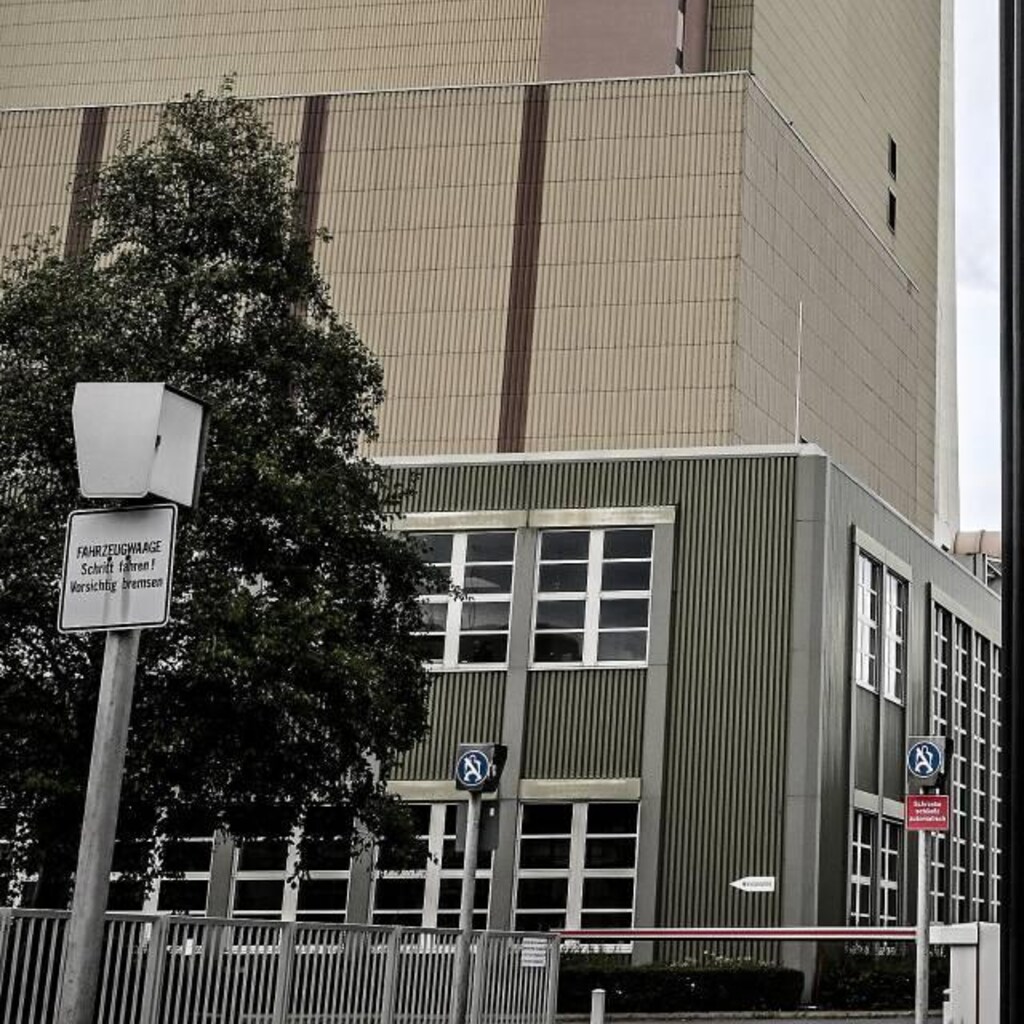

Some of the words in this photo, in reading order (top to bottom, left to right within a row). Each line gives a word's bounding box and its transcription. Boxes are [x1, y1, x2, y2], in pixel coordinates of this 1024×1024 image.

[77, 540, 162, 559] FAHRZEUGWAAGE
[81, 560, 114, 575] Schritt
[70, 579, 117, 594] Vorsichtig
[122, 577, 164, 590] bremsen
